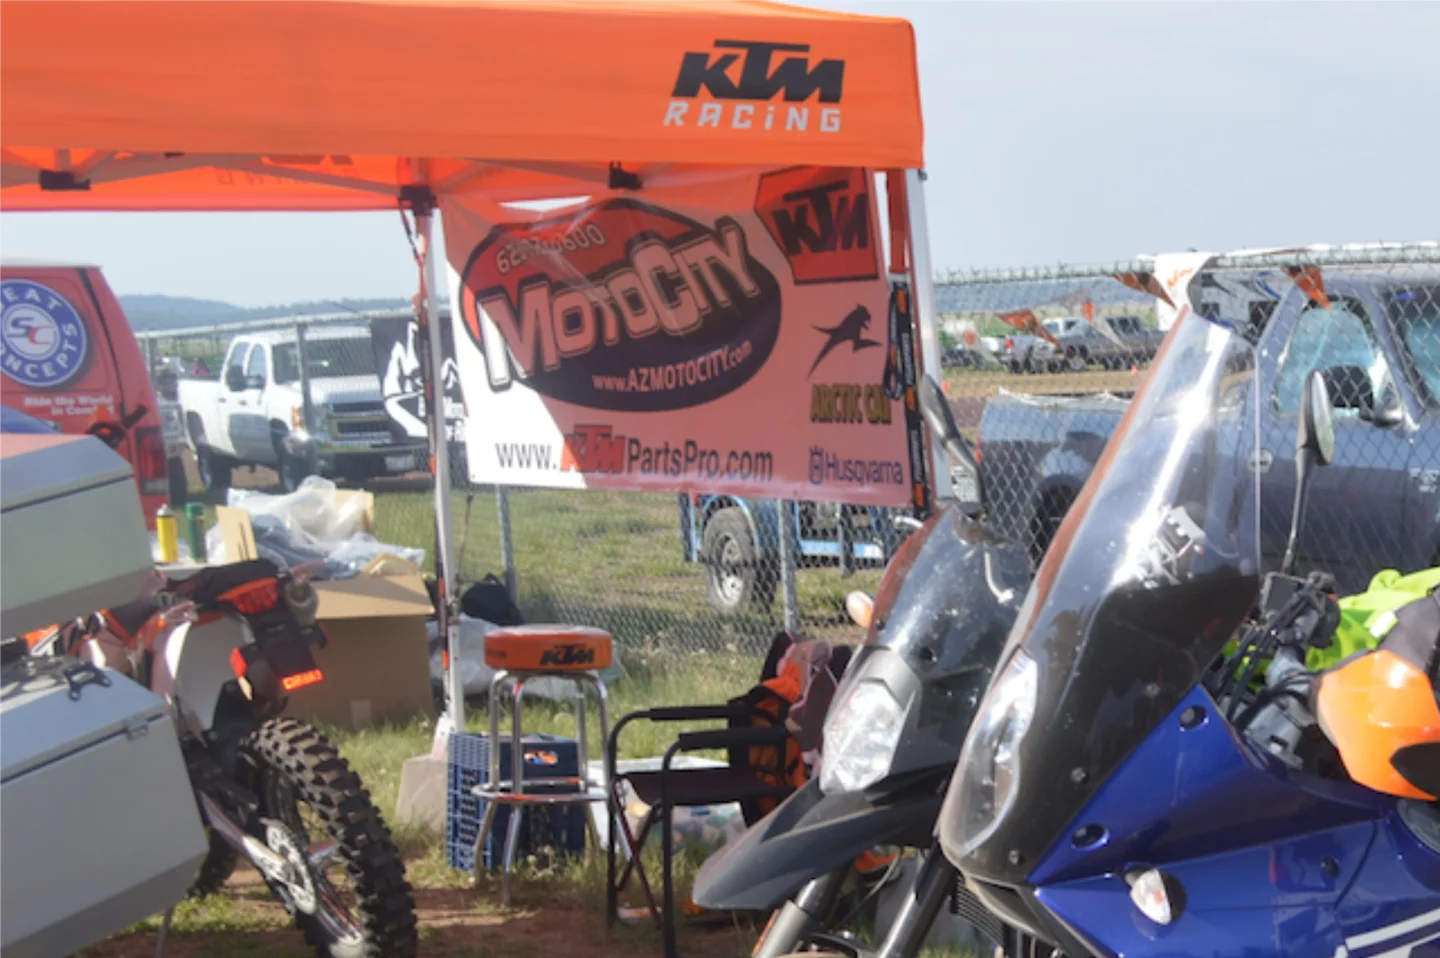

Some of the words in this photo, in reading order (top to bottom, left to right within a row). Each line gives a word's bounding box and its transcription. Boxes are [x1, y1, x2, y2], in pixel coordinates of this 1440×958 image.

[670, 39, 846, 104] KTM
[771, 180, 870, 256] KTM
[0, 287, 63, 311] EAT
[825, 452, 904, 486] Husqvarna
[539, 644, 596, 666] KTM
